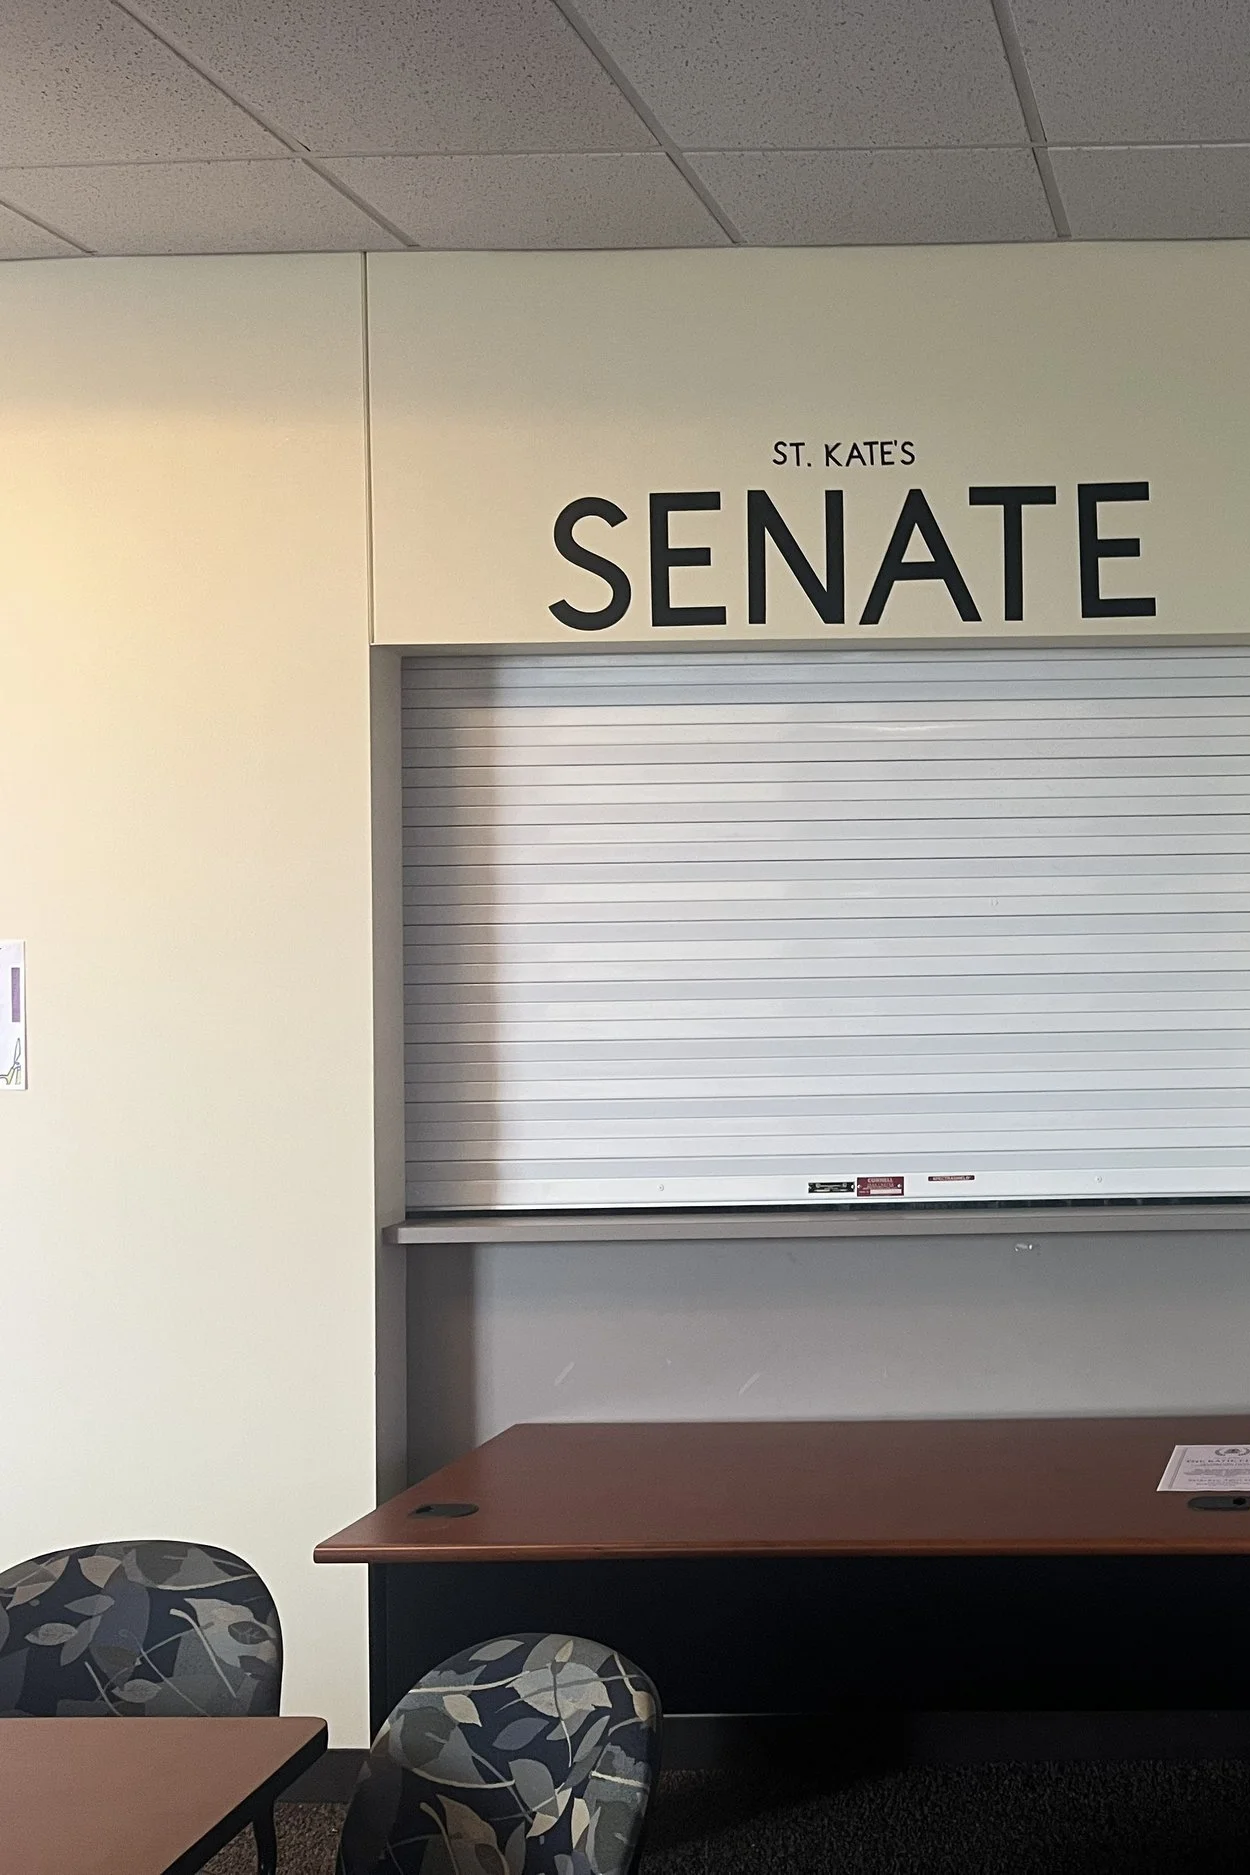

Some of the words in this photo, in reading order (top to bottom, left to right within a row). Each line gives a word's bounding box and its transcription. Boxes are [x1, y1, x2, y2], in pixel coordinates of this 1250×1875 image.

[772, 440, 812, 467] ST.
[825, 439, 916, 467] KATE'S
[547, 481, 1157, 631] SENATE
